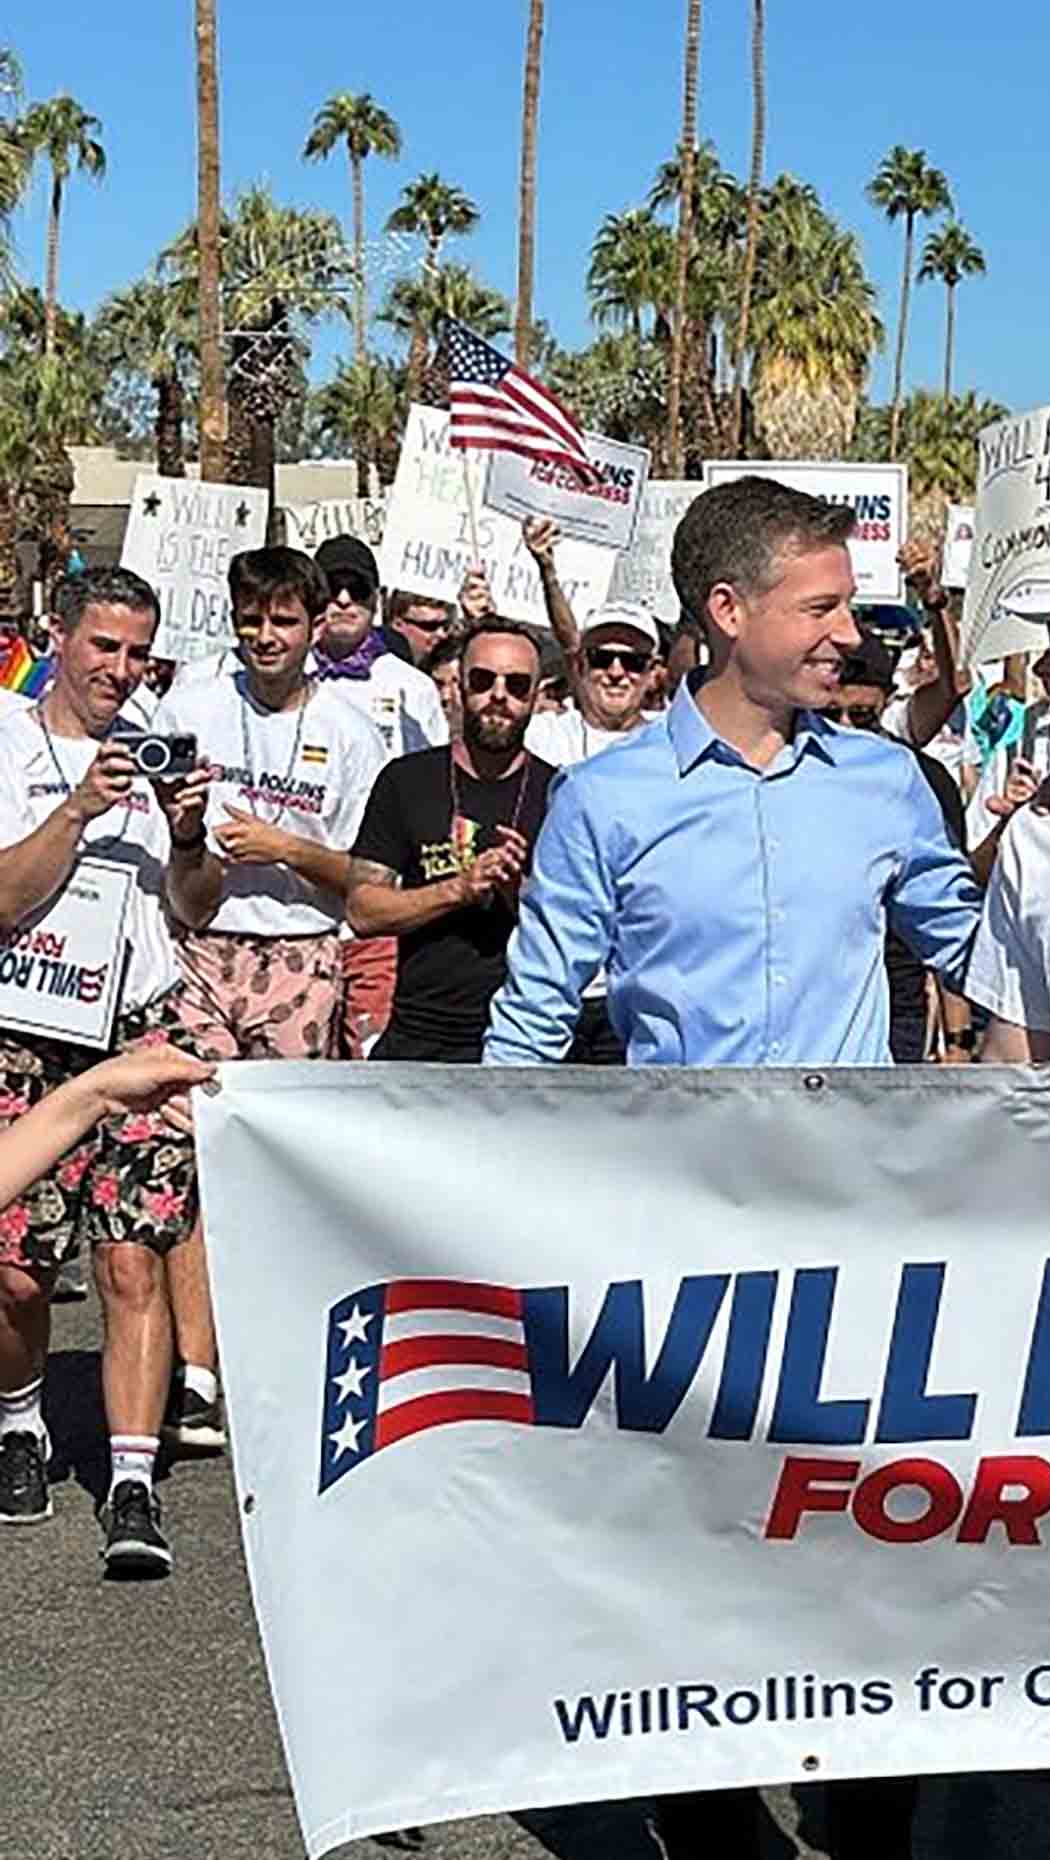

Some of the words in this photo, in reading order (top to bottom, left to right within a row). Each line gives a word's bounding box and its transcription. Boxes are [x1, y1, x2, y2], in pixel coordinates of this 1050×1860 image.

[189, 534, 229, 576] THE
[37, 958, 81, 1001] WILL
[520, 1262, 978, 1445] WILL
[554, 1673, 894, 1743] WillRollins
[914, 1667, 1005, 1712] for
